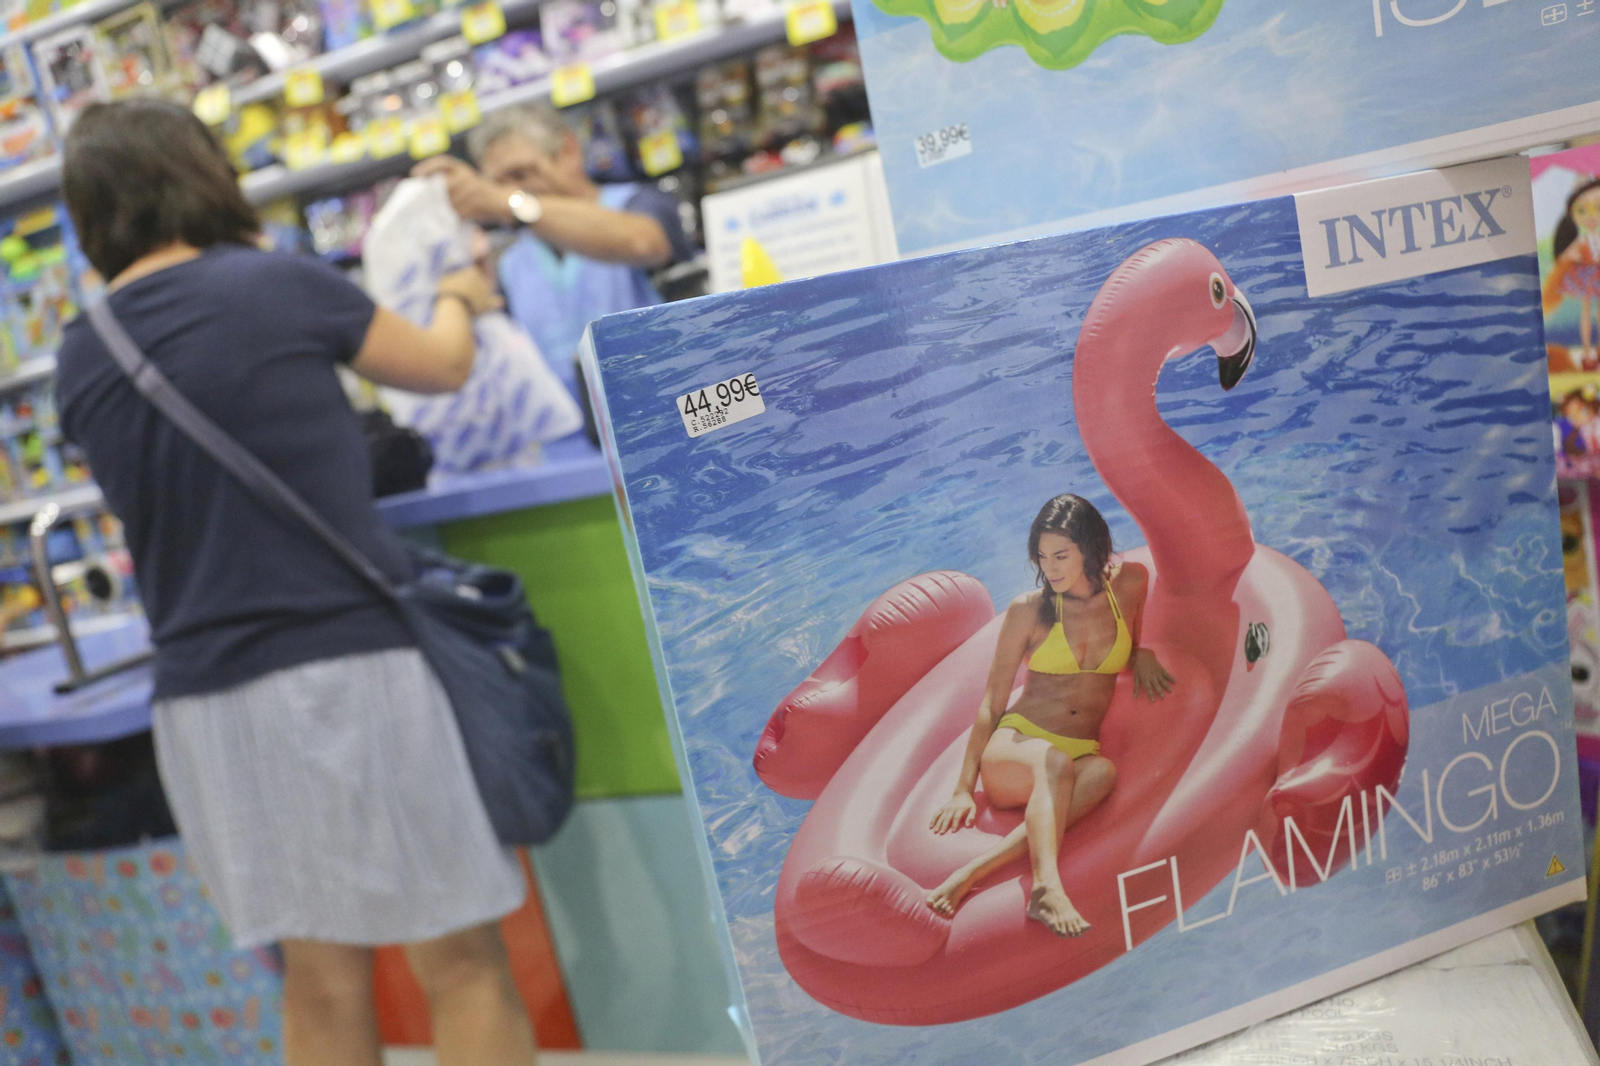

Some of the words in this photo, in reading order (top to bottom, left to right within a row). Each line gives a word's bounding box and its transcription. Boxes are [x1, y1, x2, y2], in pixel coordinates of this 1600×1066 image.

[684, 373, 760, 417] 44,99€
[1462, 686, 1557, 744] MEGA
[1117, 730, 1561, 951] FLAMINGO
[1421, 850, 1460, 872] 2.18m
[1463, 844, 1471, 854] x
[1475, 830, 1511, 852] 2.11m
[1515, 825, 1523, 837] x
[1527, 811, 1565, 832] 1.36m
[1446, 870, 1454, 882] x
[1482, 858, 1490, 869] x
[1360, 1043, 1399, 1054] KGS
